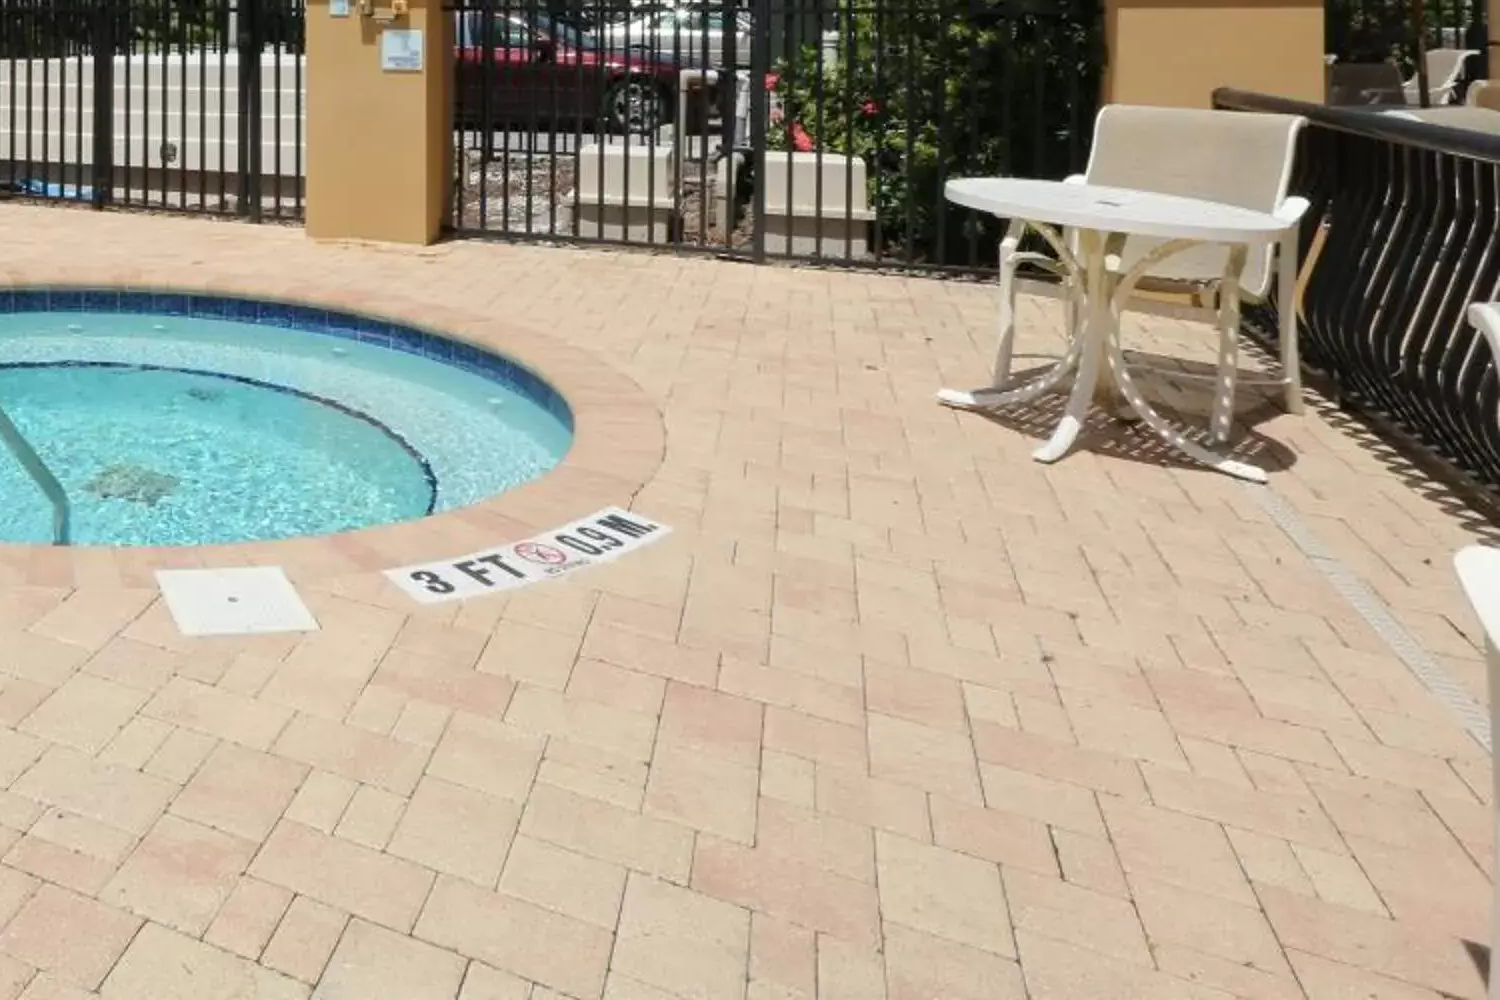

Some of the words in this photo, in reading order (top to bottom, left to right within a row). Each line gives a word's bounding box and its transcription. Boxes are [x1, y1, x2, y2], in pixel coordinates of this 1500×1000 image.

[410, 571, 456, 594] 3
[452, 554, 527, 586] FT
[555, 527, 624, 555] 0.9
